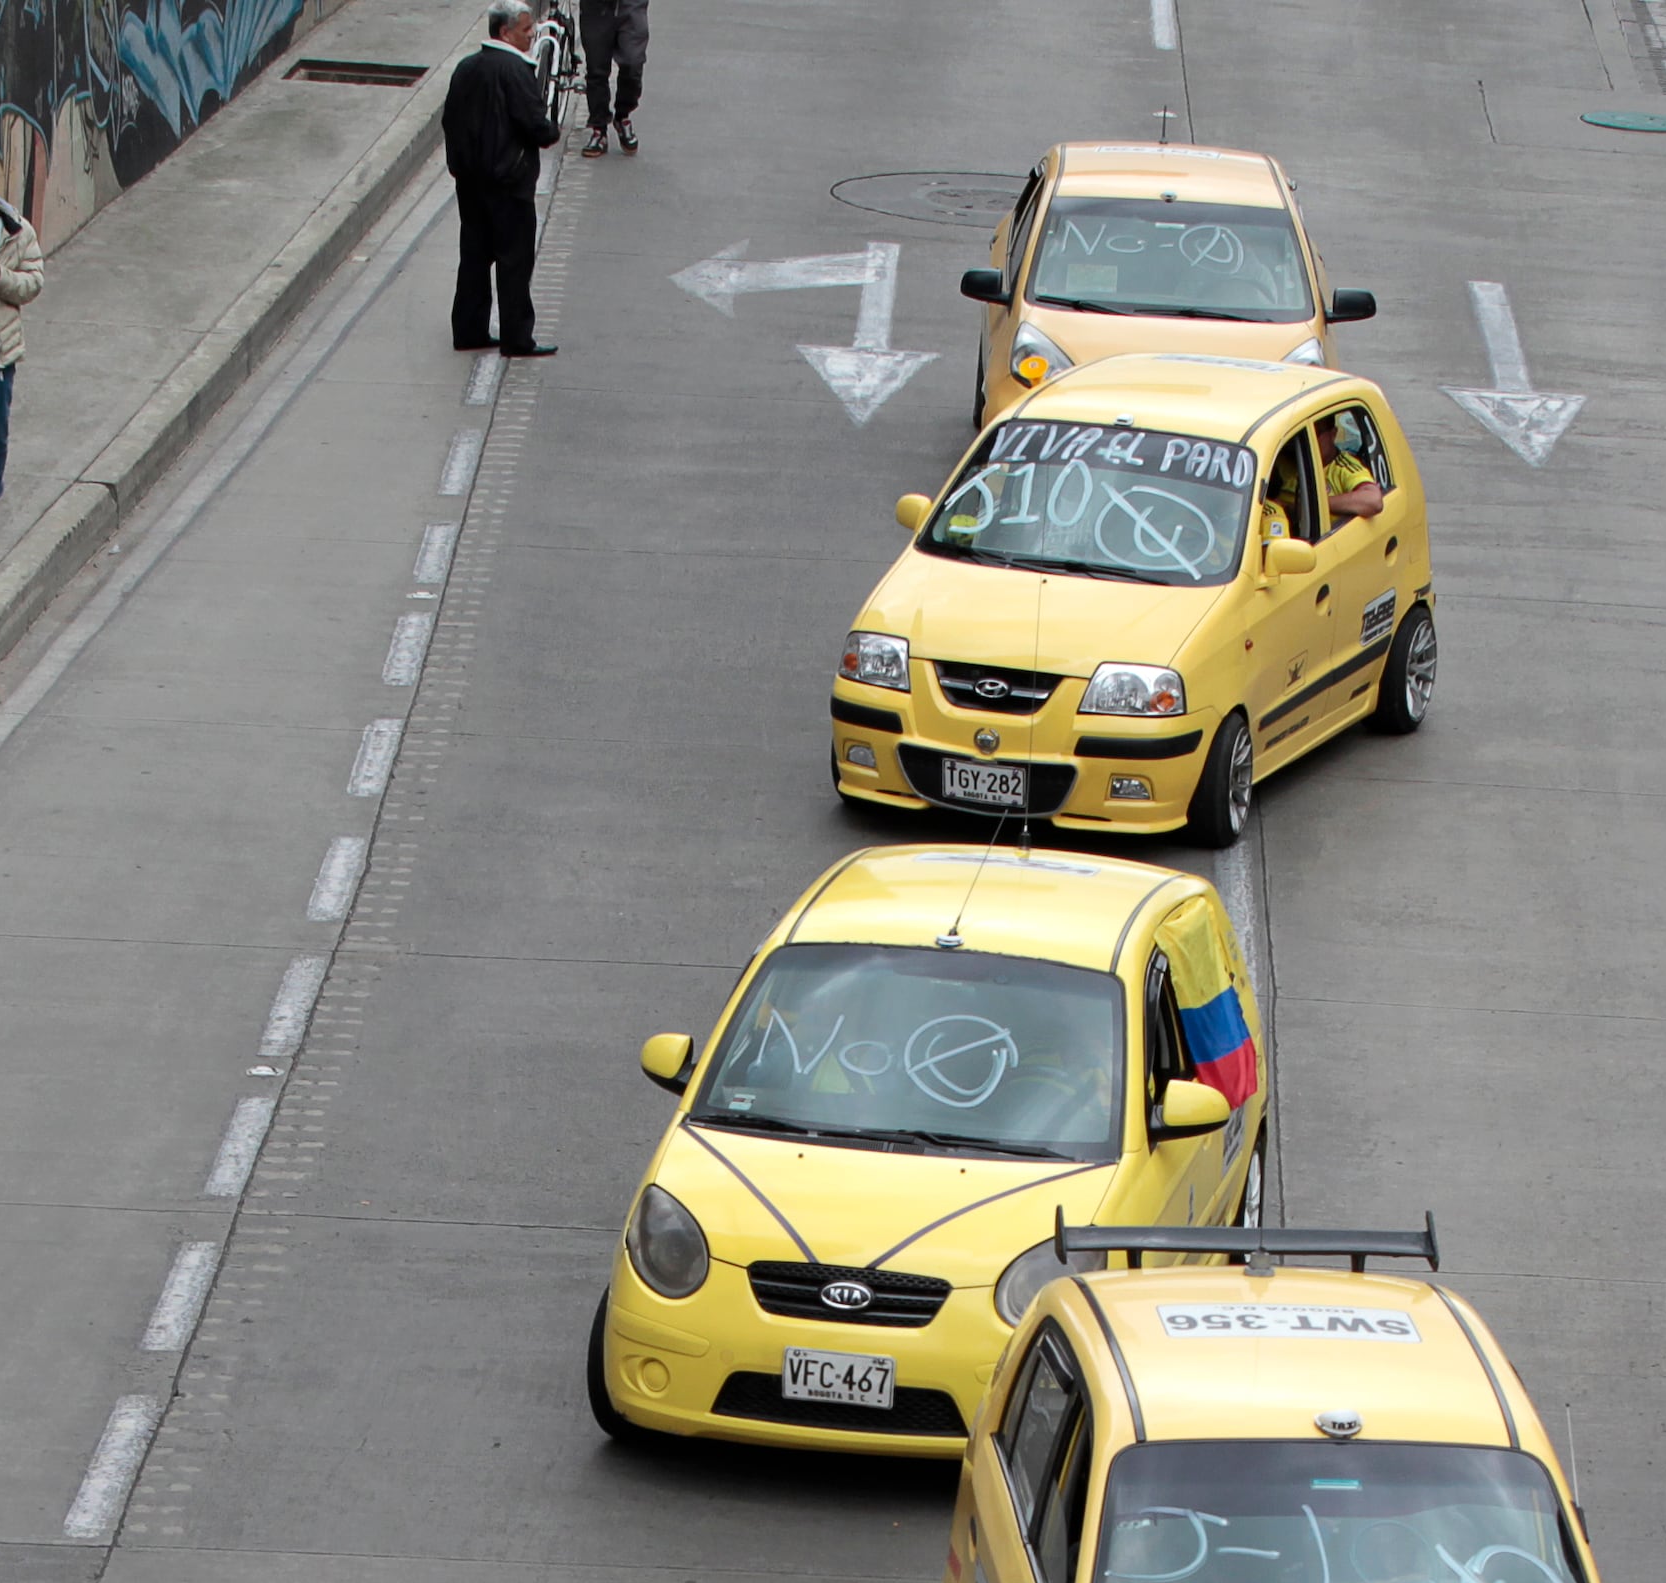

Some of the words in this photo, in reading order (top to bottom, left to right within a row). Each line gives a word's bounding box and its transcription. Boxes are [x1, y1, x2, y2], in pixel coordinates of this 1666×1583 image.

[988, 423, 1104, 463] VIVA
[828, 1286, 863, 1304] KIA
[1330, 1420, 1357, 1431] TAXI
